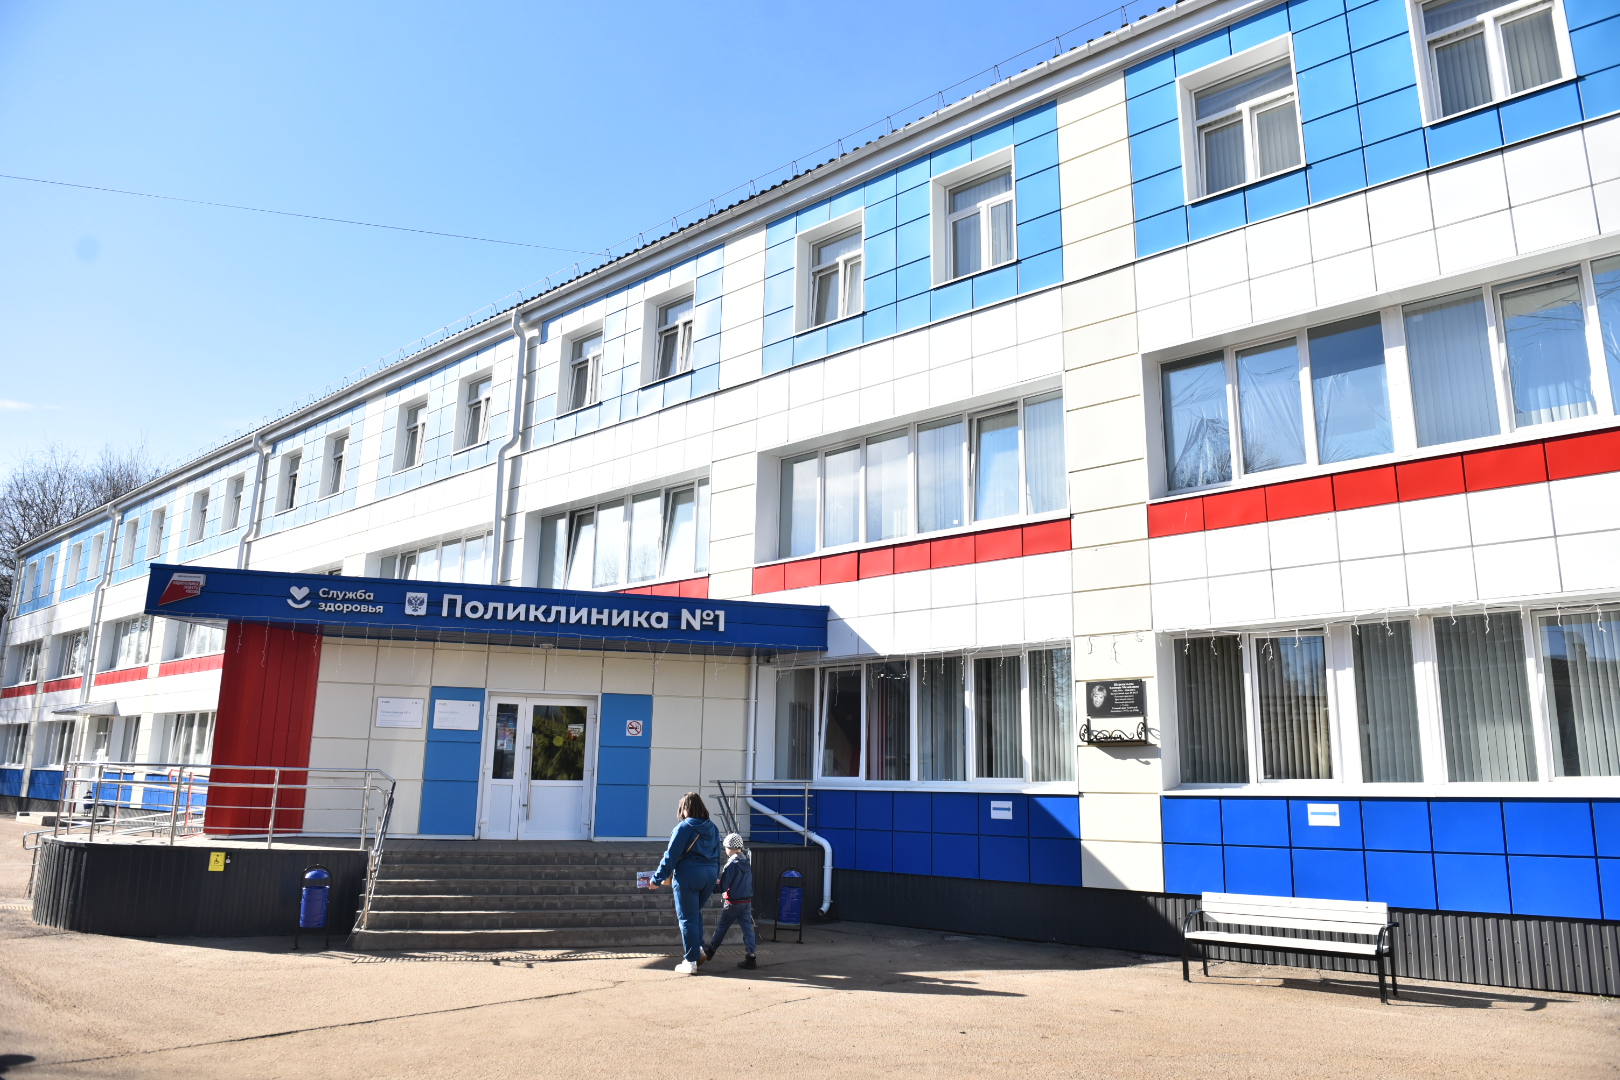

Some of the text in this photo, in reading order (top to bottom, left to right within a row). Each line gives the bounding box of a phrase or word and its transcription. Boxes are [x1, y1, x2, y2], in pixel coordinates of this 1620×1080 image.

[318, 588, 374, 600] Служба
[318, 602, 384, 613] здоровья
[441, 593, 725, 632] Поликлиника №1
